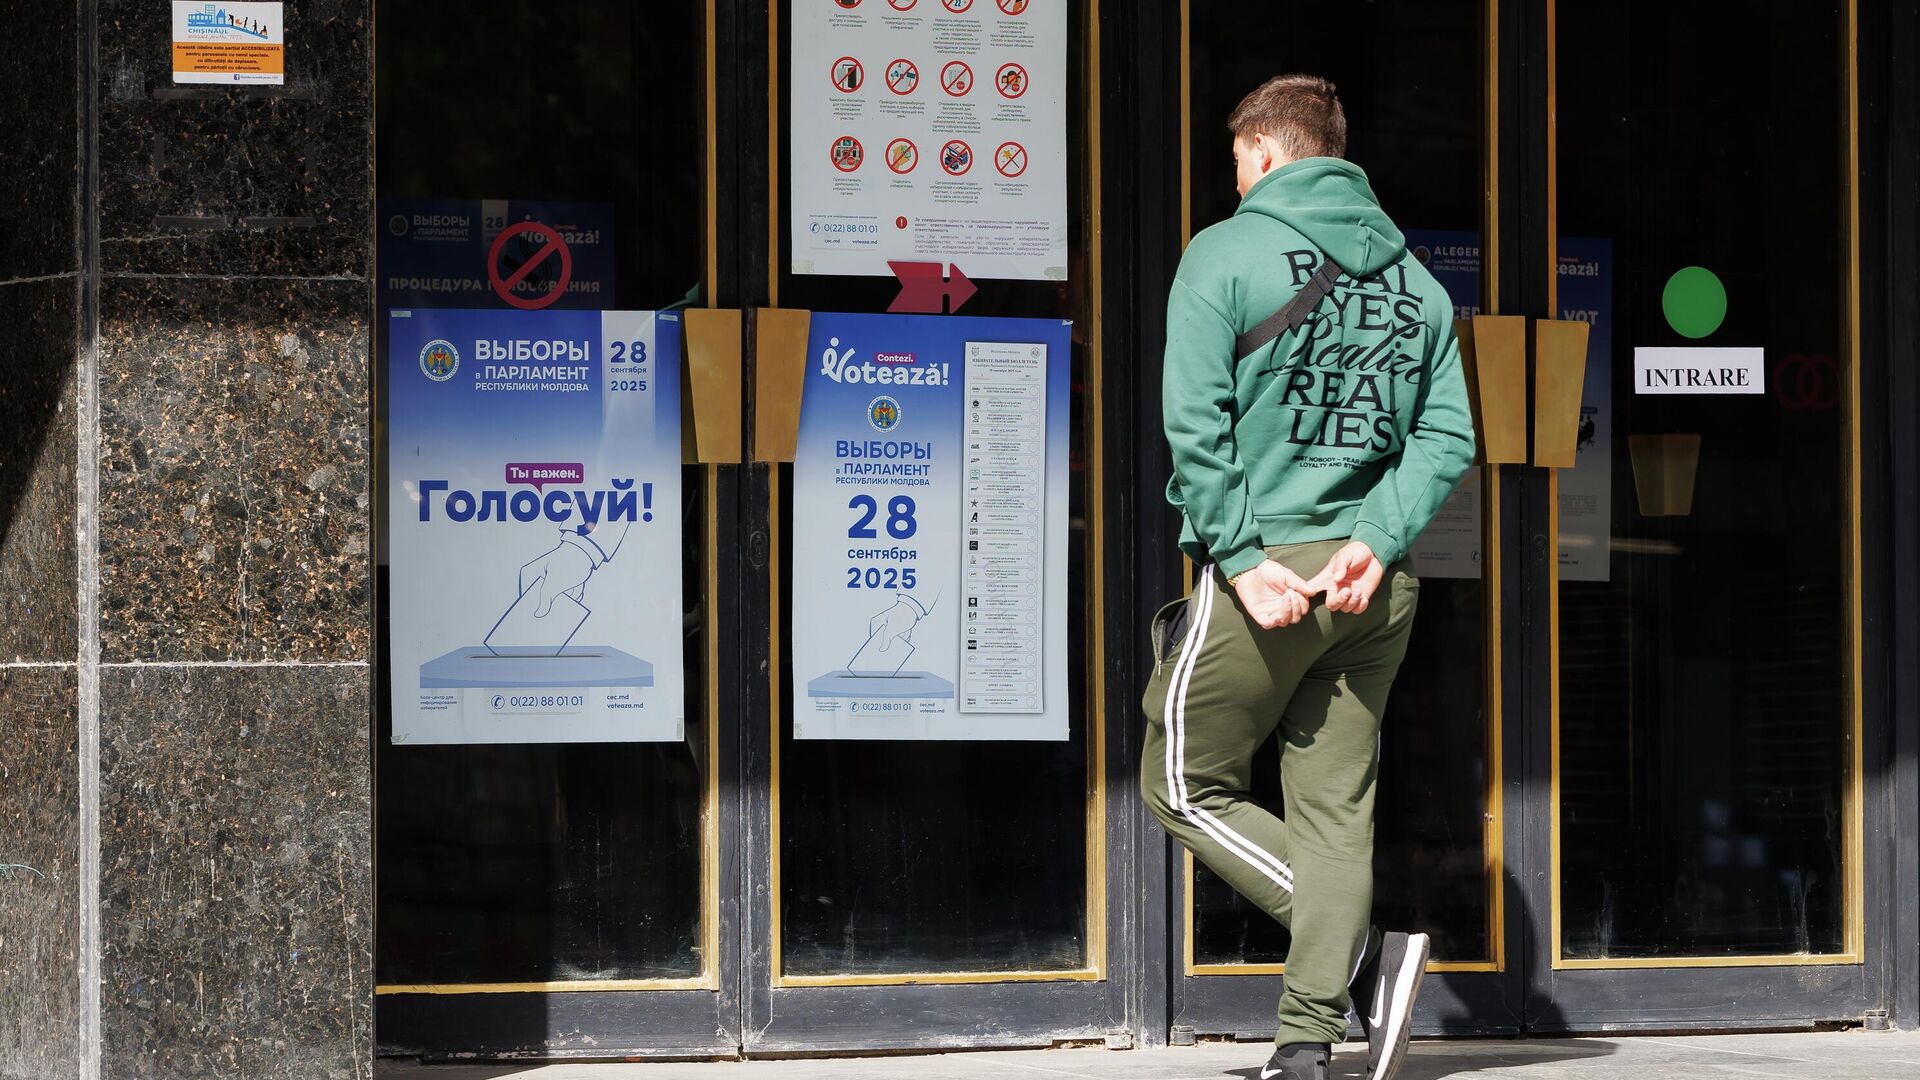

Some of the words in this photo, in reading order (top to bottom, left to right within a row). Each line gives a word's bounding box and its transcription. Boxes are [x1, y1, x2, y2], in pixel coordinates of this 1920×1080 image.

[413, 215, 470, 226] ВЫБОРЫ
[417, 228, 470, 237] ПАРЛАМЕНТ
[823, 223, 845, 233] 0(22)
[846, 224, 857, 233] 88
[858, 224, 867, 233] 01
[869, 225, 878, 233] 01
[389, 277, 482, 292] ПРОЦЕДУРА
[1295, 290, 1422, 340] YES
[1563, 310, 1599, 326] VOT
[475, 340, 590, 361] ВЫБОРЫ
[610, 341, 647, 363] 28
[877, 353, 914, 363] Contezi.
[485, 366, 590, 380] ПАРЛАМЕНТ
[610, 366, 647, 375] сентября
[1645, 368, 1750, 387] INTRARE
[475, 382, 539, 392] РЕСПУБЛИКИ
[541, 383, 590, 393] МОЛДОВА
[610, 380, 647, 392] 2025
[1285, 408, 1394, 453] LIES
[835, 440, 932, 460] ВЫБОРЫ
[1342, 456, 1360, 465] FEAR
[509, 467, 529, 479] Ты
[532, 468, 580, 479] важен.
[844, 463, 931, 476] ПАРЛАМЕНТ
[835, 476, 889, 486] РЕСПУБЛИКИ
[890, 477, 931, 487] МОЛДОВА
[418, 477, 653, 537] Голосуй!
[847, 494, 918, 540] 28
[847, 547, 917, 562] сентября
[847, 567, 917, 590] 2025
[510, 696, 538, 707] 0(22)
[540, 696, 554, 707] 88
[556, 696, 569, 707] 01
[571, 696, 584, 706] 01
[862, 702, 881, 712] 0(22)
[882, 702, 892, 711] 88
[893, 703, 903, 711] 01
[904, 703, 912, 711] 01
